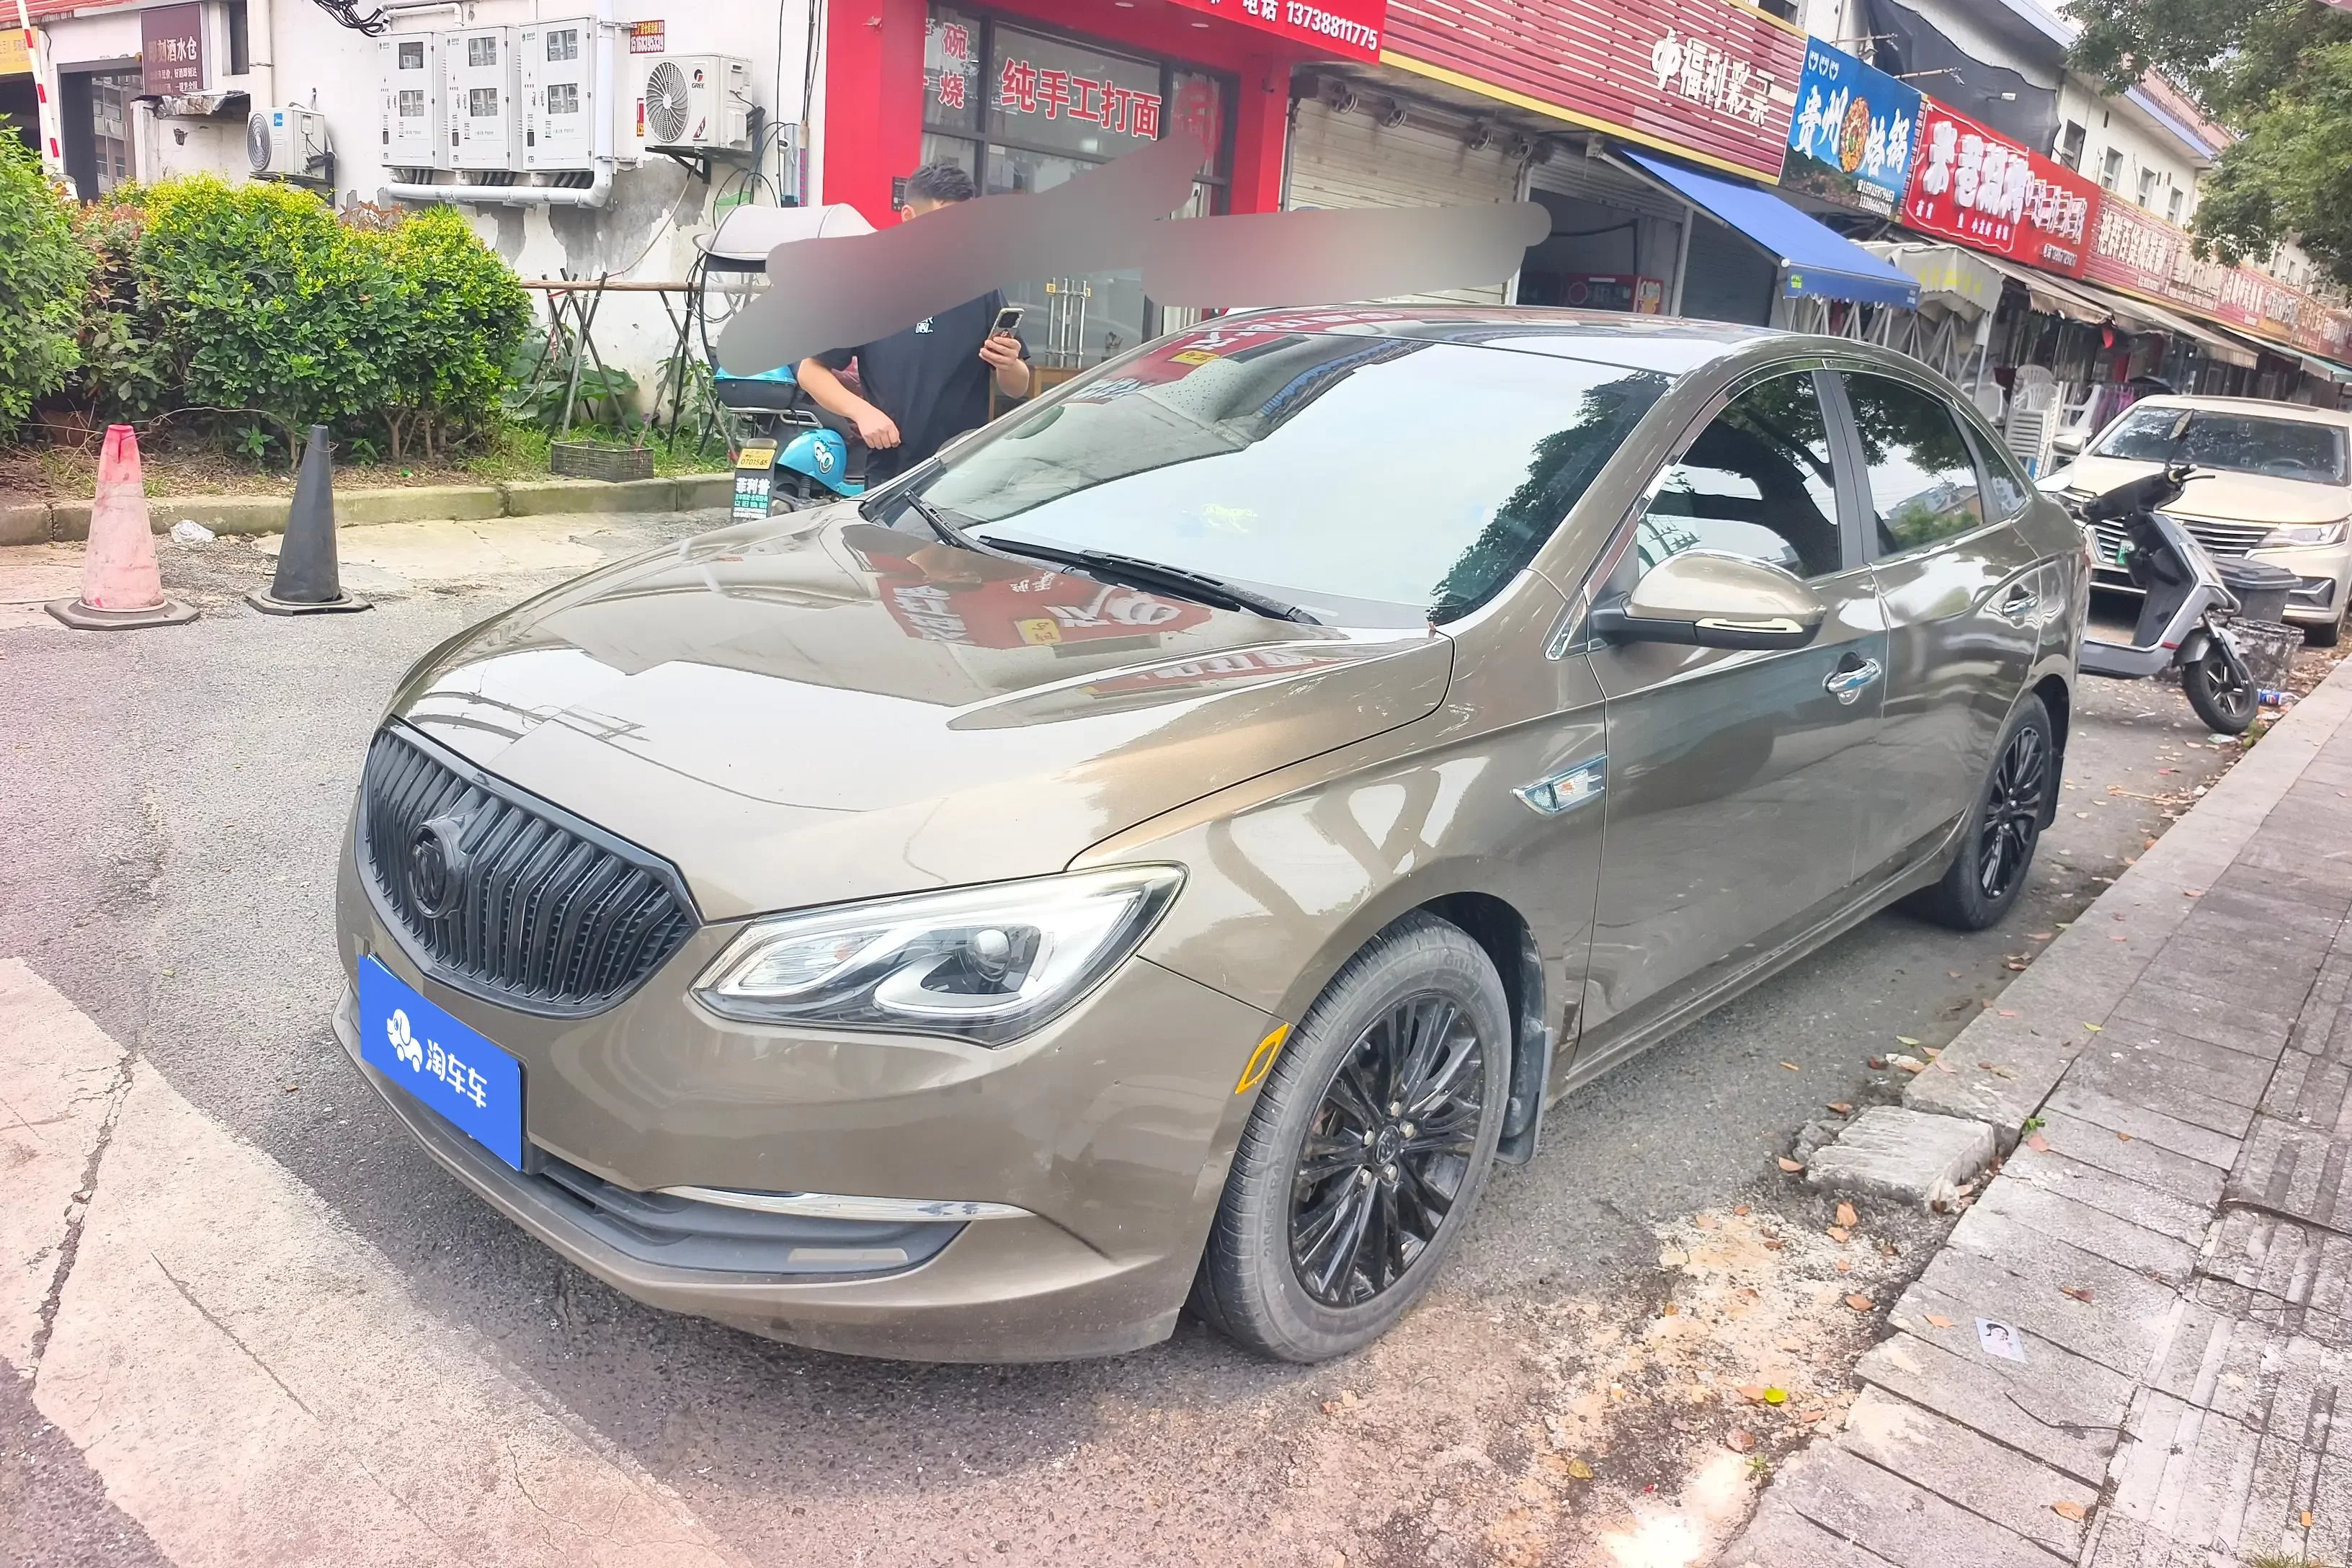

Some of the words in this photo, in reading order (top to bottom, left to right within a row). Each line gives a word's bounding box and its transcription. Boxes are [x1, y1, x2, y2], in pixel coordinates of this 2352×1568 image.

[1242, 0, 1278, 22] 电话
[1286, 1, 1378, 50] 13738811775
[1000, 57, 1162, 141] 纯手工打面
